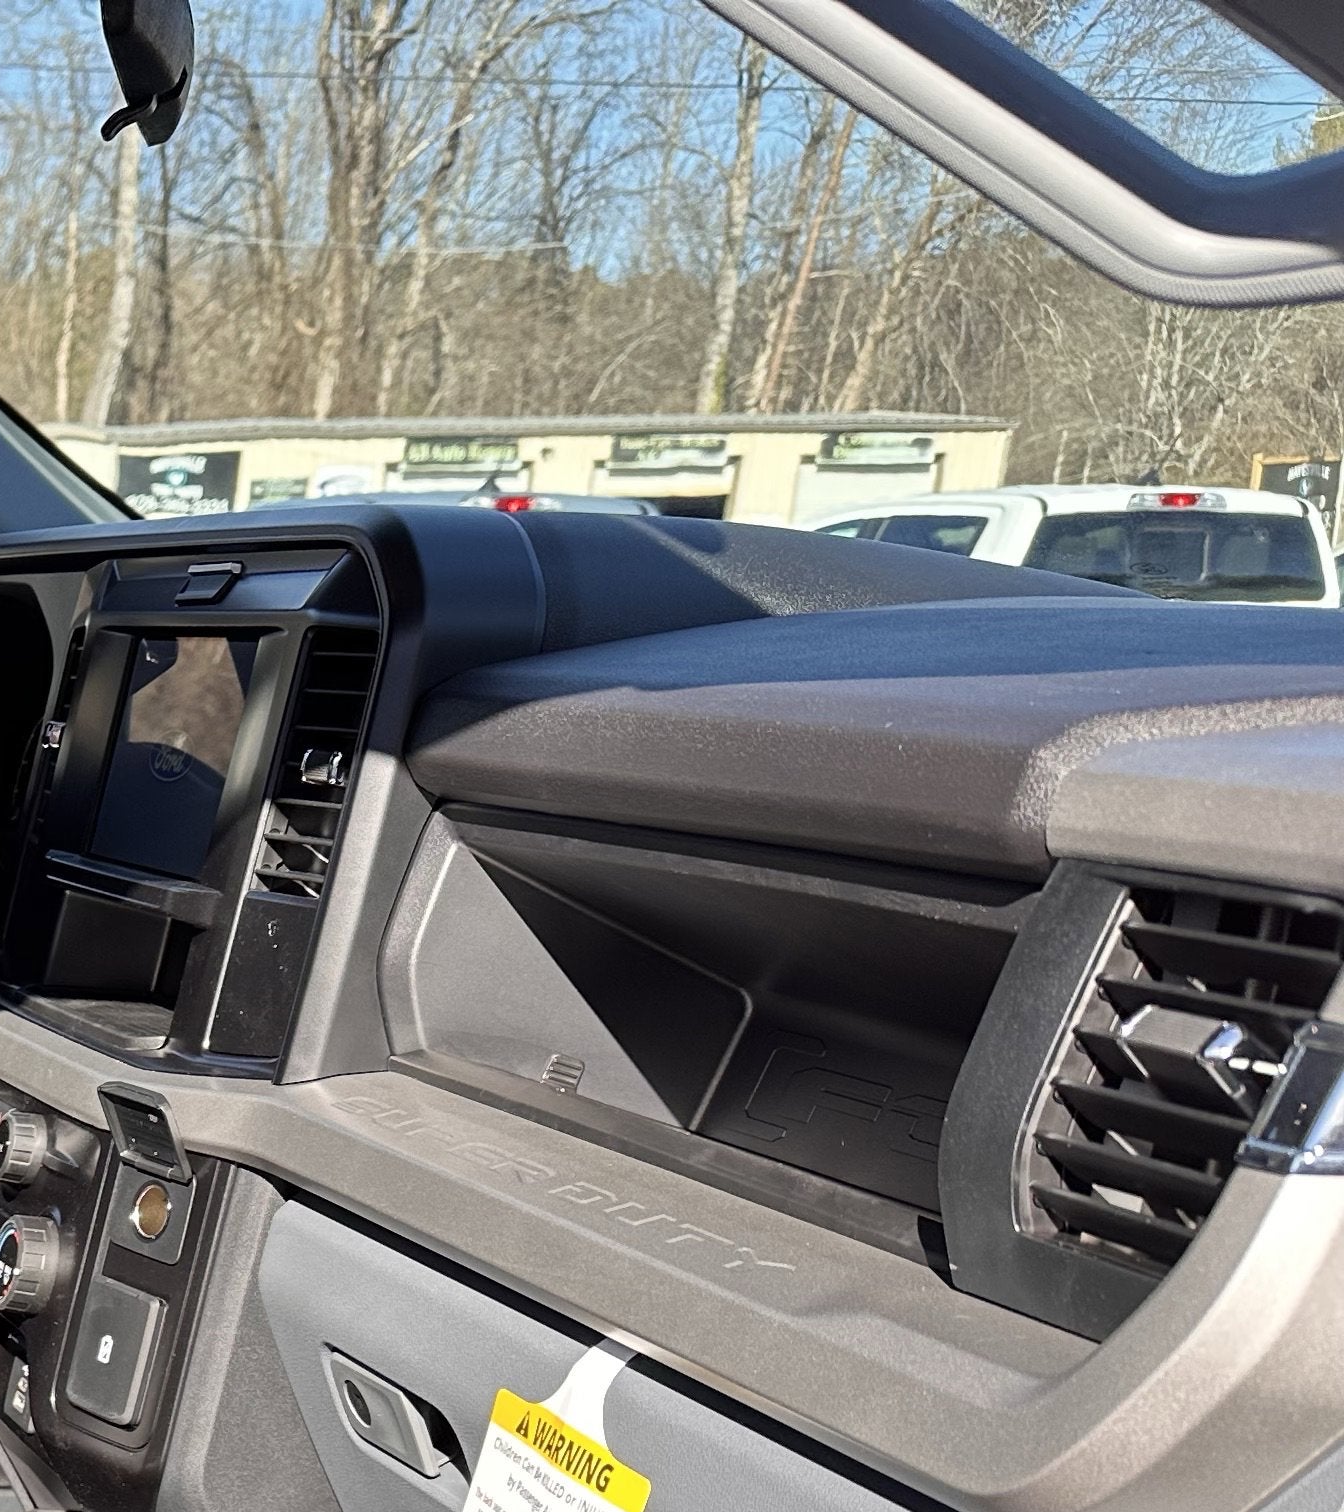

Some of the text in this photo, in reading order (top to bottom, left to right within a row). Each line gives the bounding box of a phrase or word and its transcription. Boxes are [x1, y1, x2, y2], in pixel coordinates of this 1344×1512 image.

[330, 1095, 796, 1271] SUPER DUTY
[494, 1437, 522, 1465] Children
[541, 1474, 565, 1499] KILLED
[533, 1418, 615, 1493] WARNING
